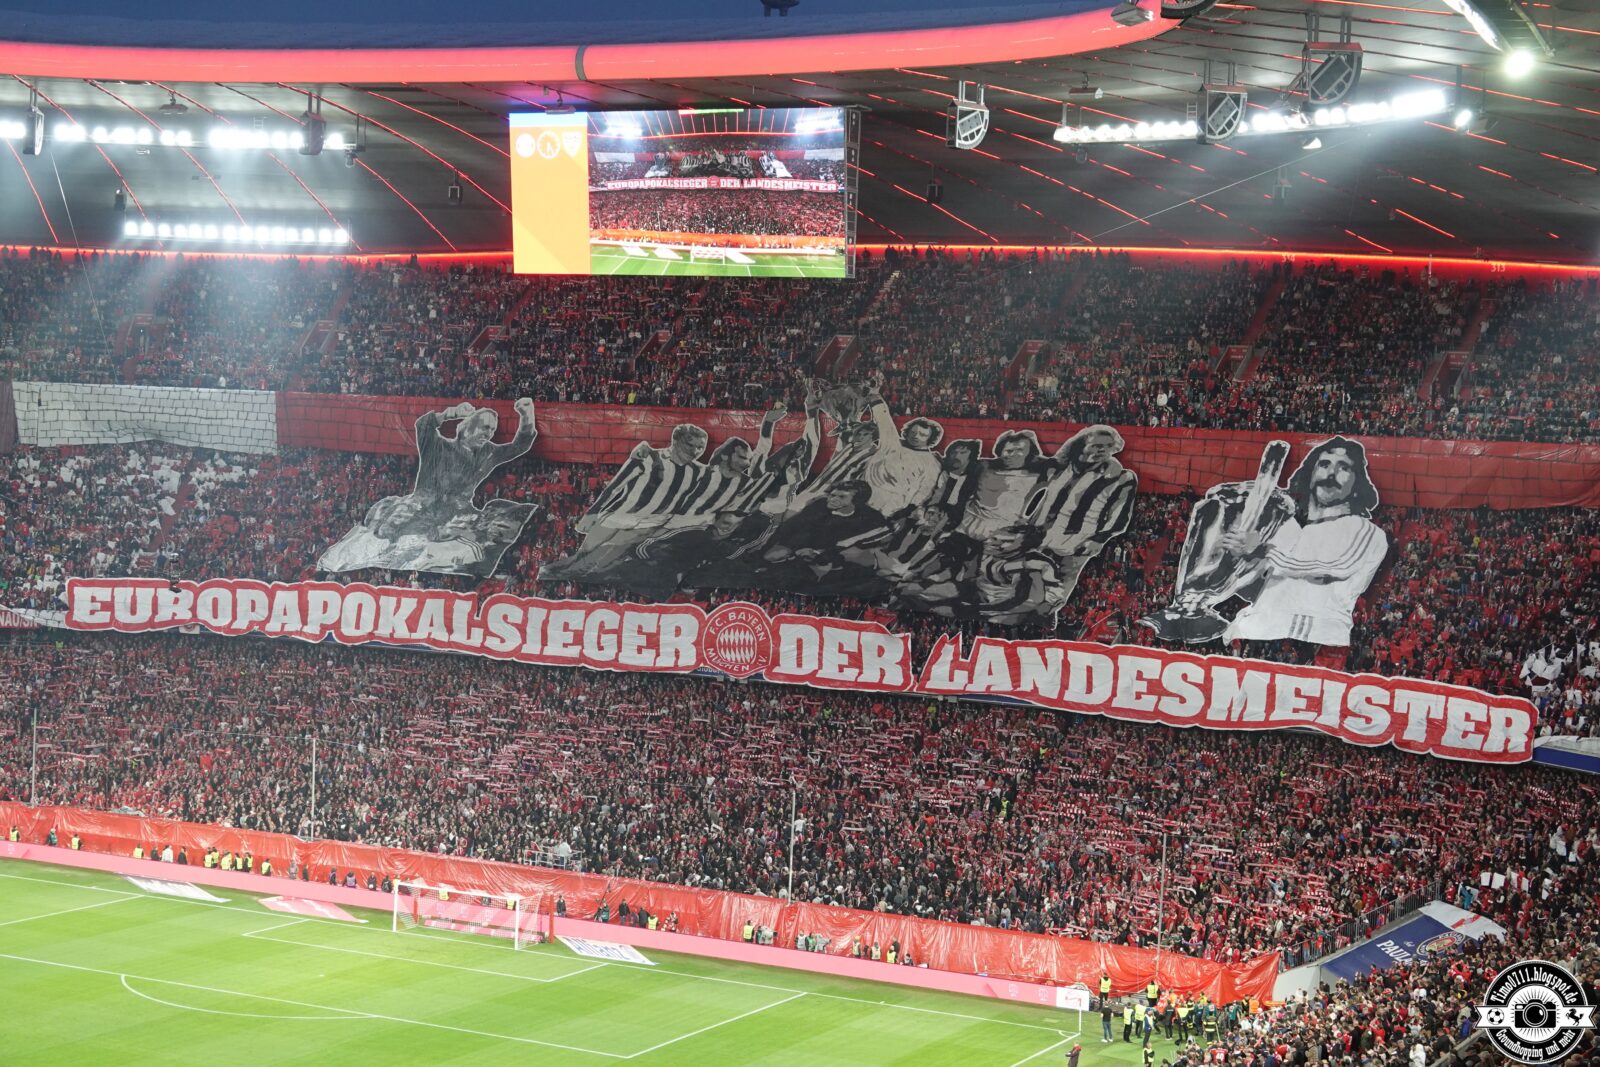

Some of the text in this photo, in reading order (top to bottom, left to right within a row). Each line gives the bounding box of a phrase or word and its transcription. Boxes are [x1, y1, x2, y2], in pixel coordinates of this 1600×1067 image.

[607, 178, 837, 191] EUROPAPOKALSIEGER DER LANDESMEISTER
[728, 612, 767, 642] BAYERN
[72, 586, 1531, 753] EUROPAPOKALSIEGER DER LANDESMEISTER
